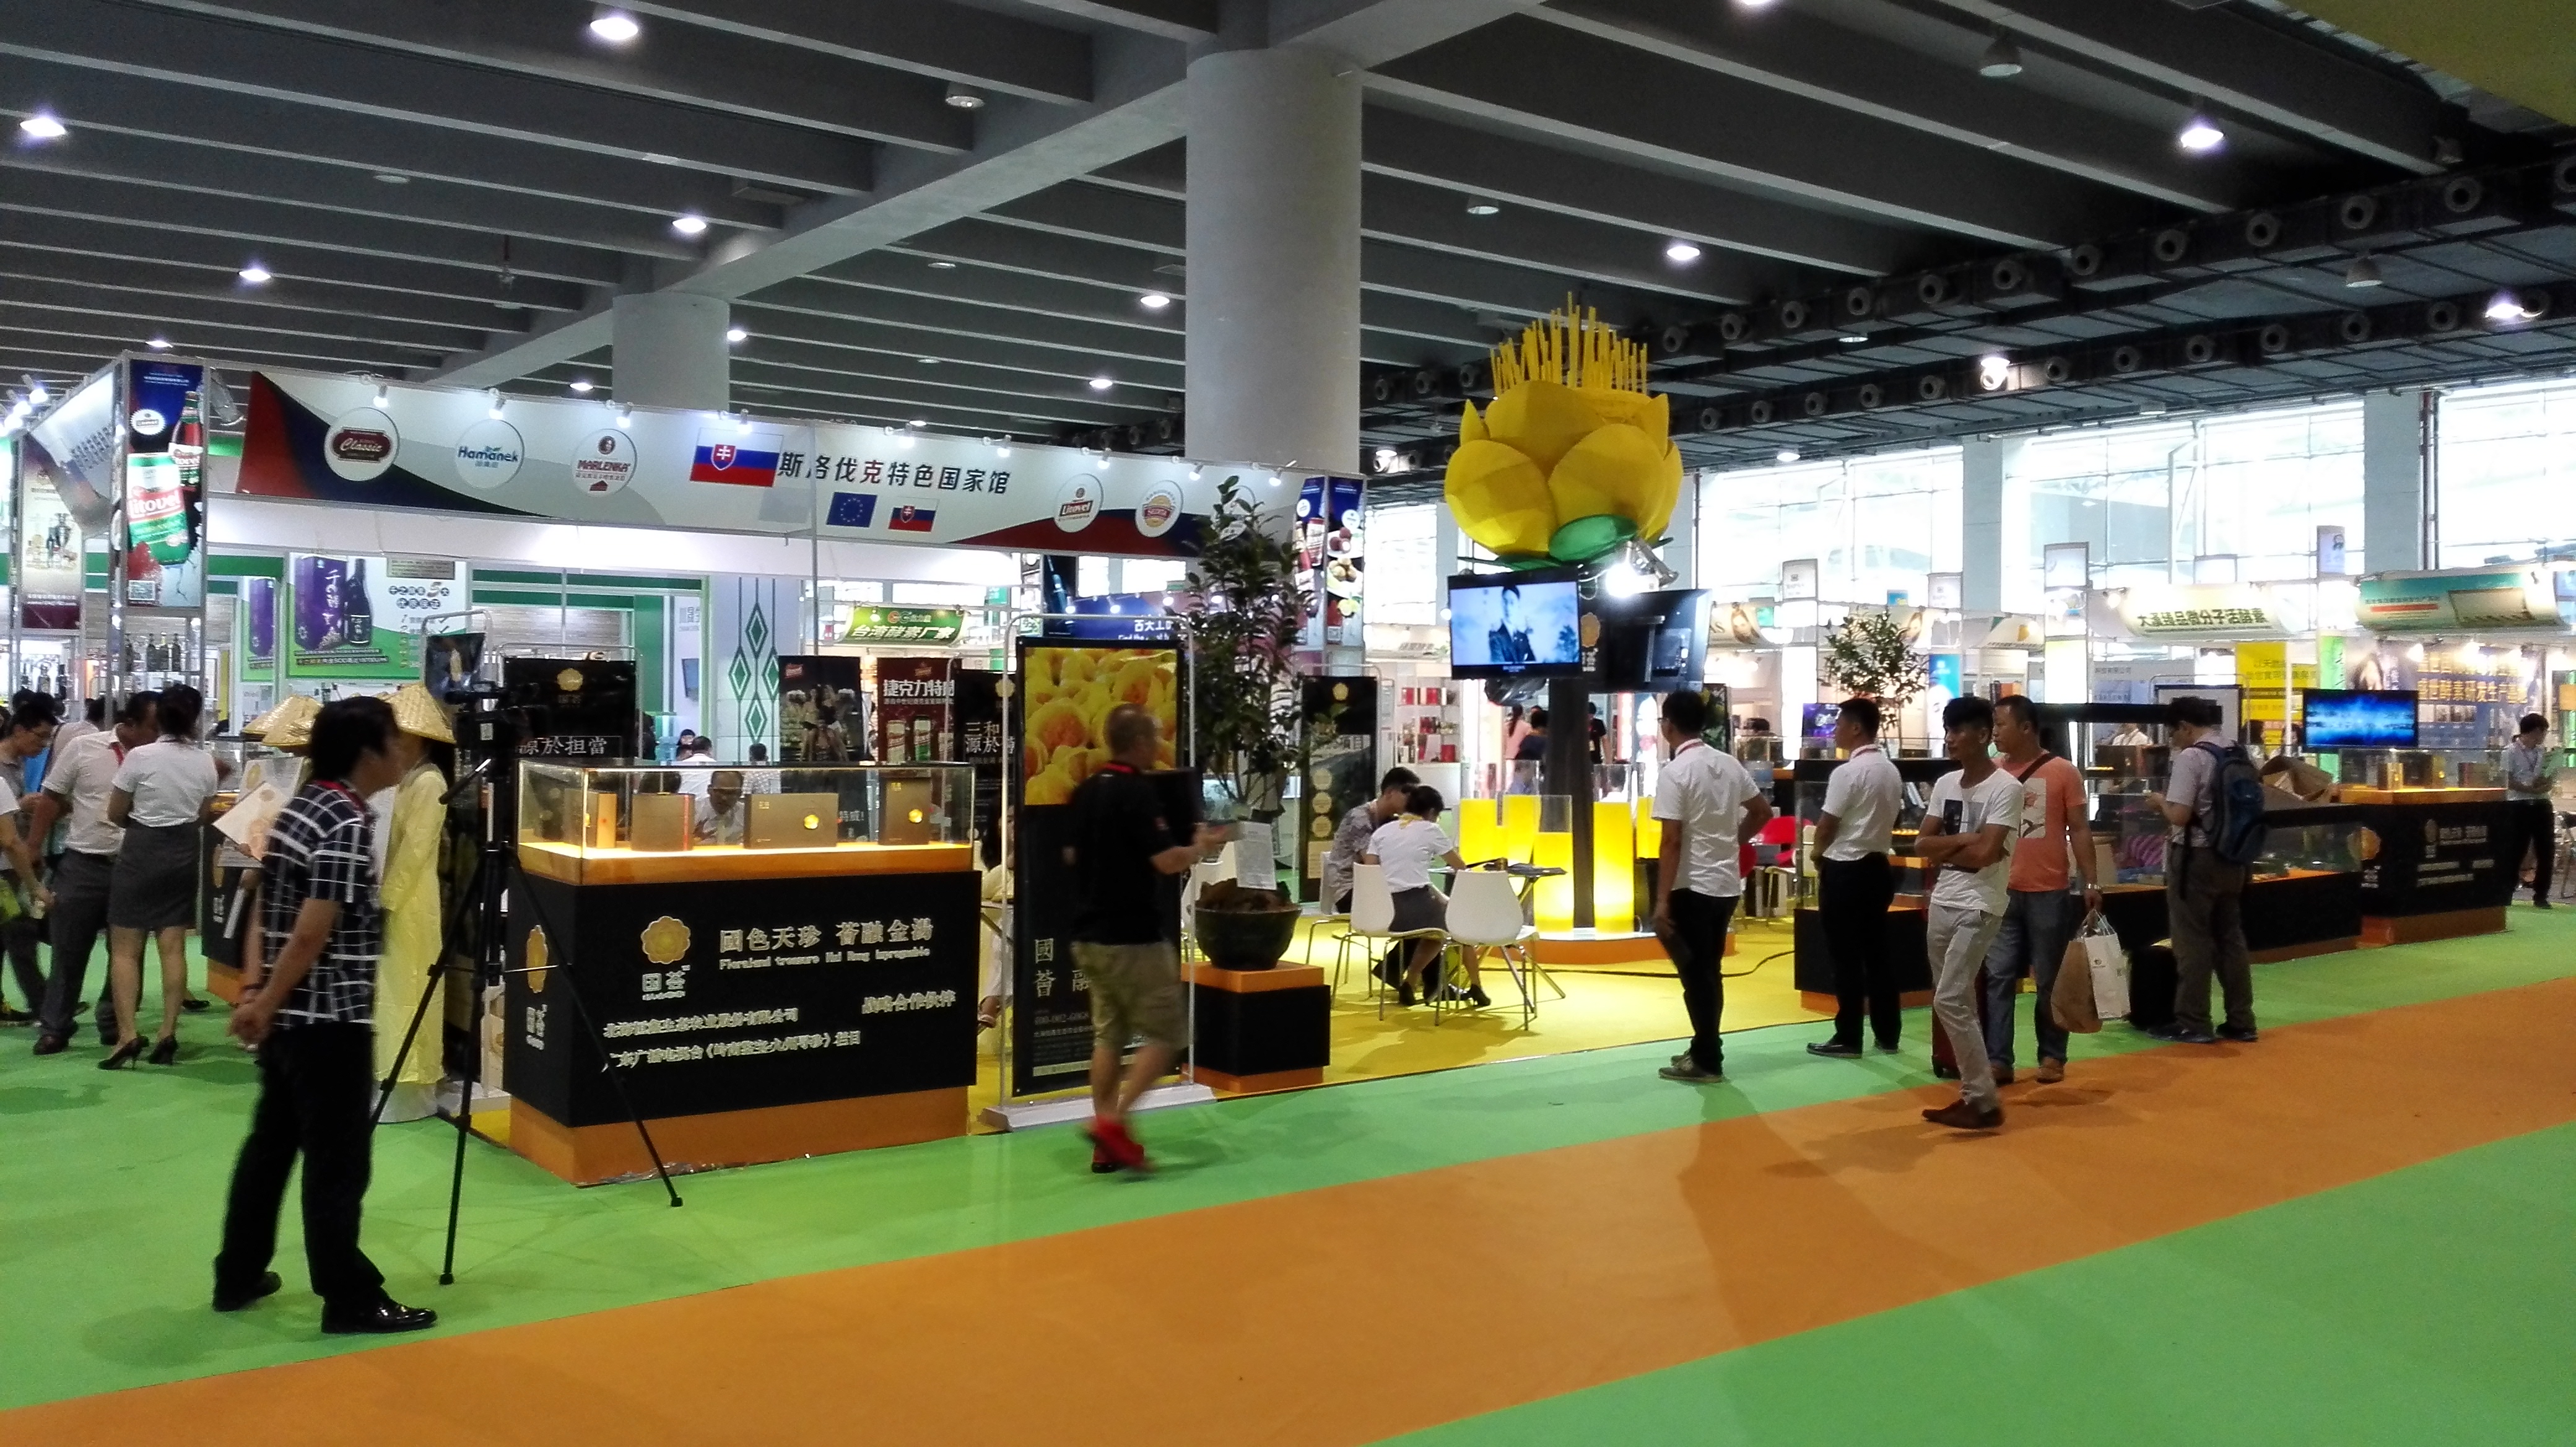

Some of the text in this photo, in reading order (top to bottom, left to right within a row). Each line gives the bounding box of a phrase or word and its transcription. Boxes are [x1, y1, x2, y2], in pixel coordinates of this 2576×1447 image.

[339, 437, 383, 452] Classic
[778, 452, 1011, 494] 斯洛伐克特色国家馆
